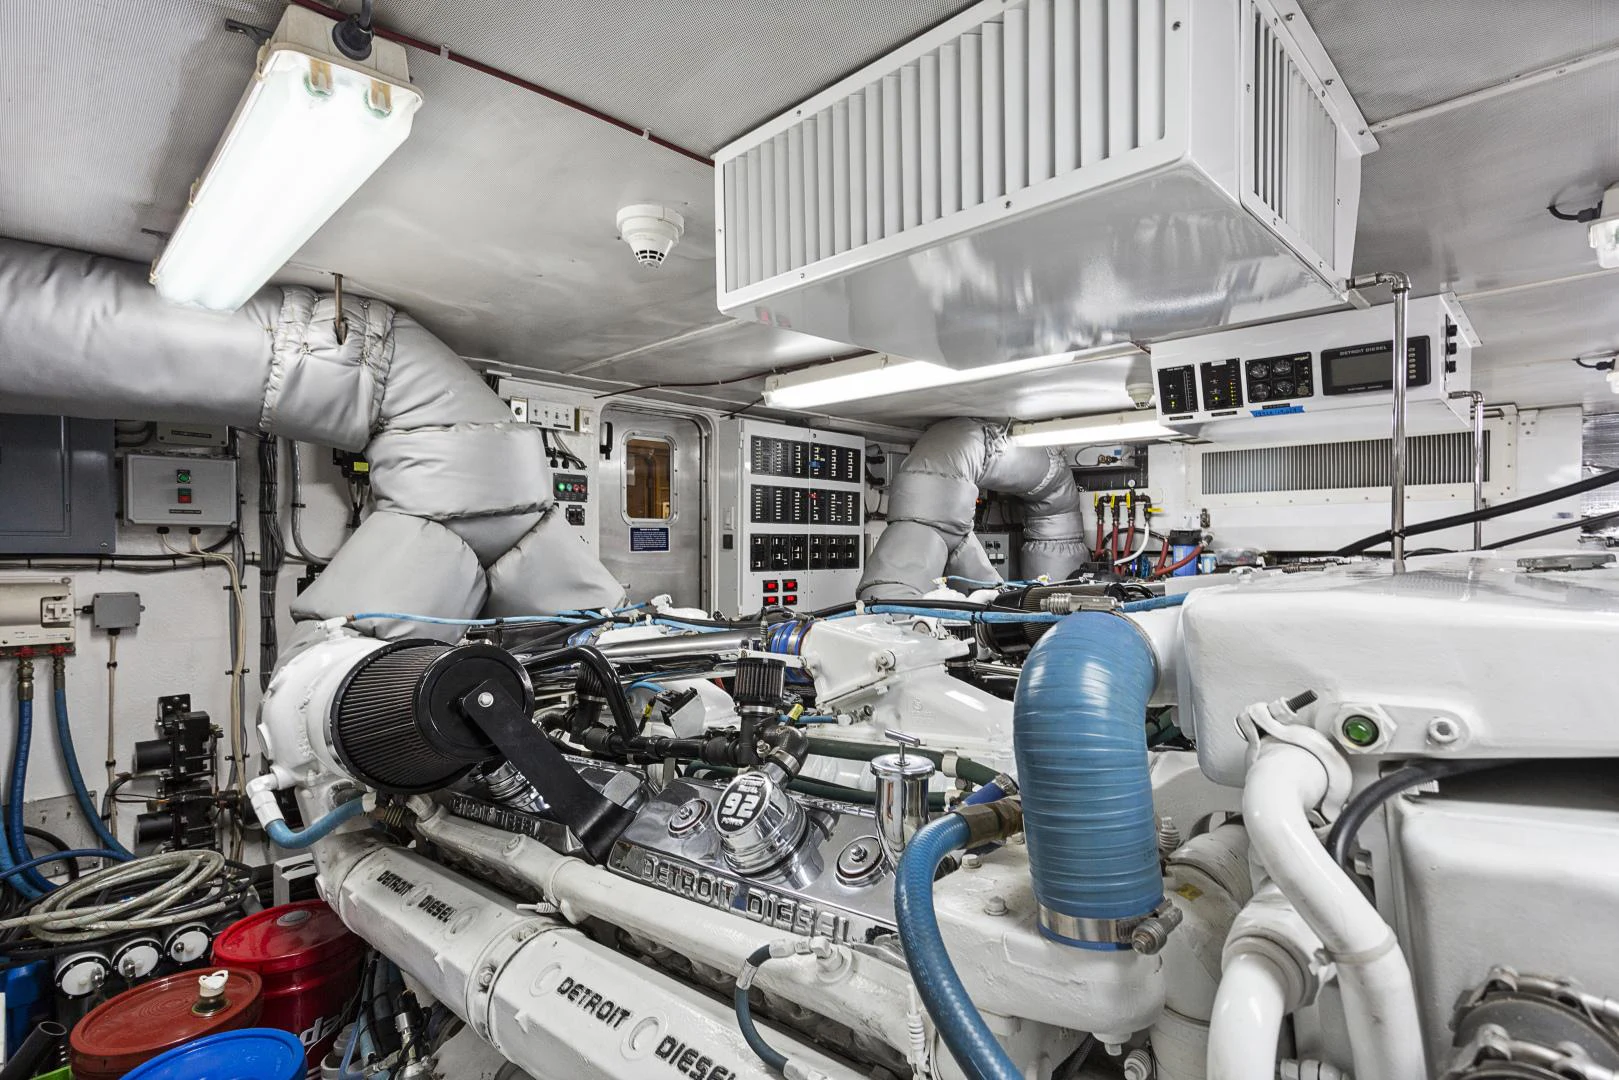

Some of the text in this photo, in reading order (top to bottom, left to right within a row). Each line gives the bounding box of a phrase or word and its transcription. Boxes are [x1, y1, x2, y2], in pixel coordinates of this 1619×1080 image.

[721, 792, 761, 819] 92
[377, 870, 455, 923] DETROIT DIESEL
[642, 853, 739, 913] DETROIT
[556, 976, 737, 1080] DETROIT DIESE
